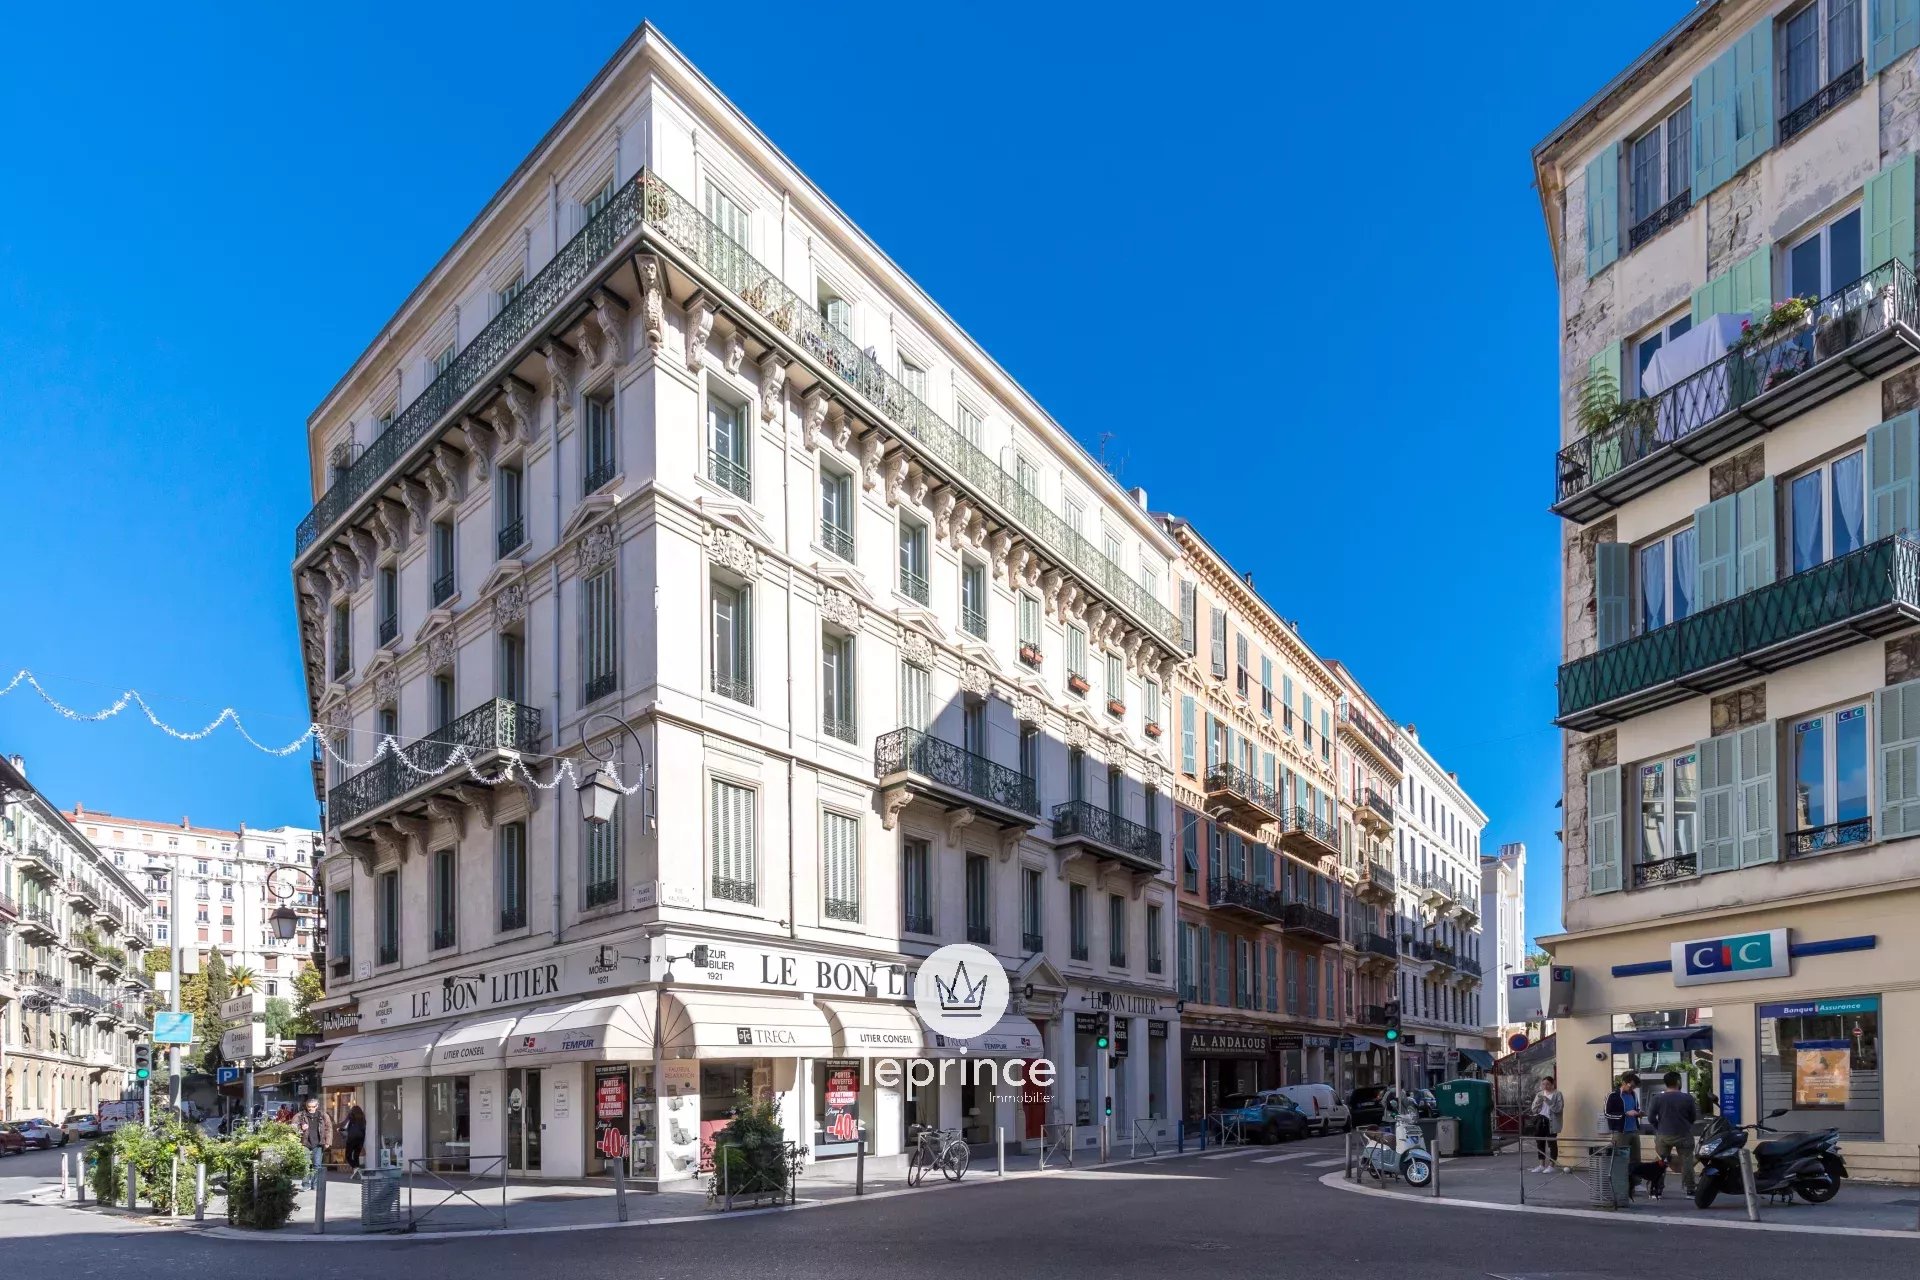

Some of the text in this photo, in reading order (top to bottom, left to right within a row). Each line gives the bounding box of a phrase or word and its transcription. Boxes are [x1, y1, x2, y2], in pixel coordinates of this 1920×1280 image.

[1692, 941, 1761, 969] CIC
[707, 971, 723, 981] 1921
[760, 954, 797, 986] LE
[816, 961, 869, 992] BON
[597, 975, 609, 985] 1921
[411, 964, 559, 1019] LE BON LITIER
[1128, 995, 1156, 1015] LITIER
[1783, 1002, 1861, 1015] Banque Assurance
[754, 1029, 796, 1044] TRECA
[860, 1033, 913, 1044] LITIER CONSEIL
[1191, 1034, 1206, 1047] AL
[1211, 1036, 1266, 1049] ANDALOUS
[561, 1039, 595, 1050] TEMPUR
[443, 1046, 485, 1060] LITIER CONSEIL
[378, 1061, 399, 1071] TEMPUR
[223, 1070, 234, 1082] P
[834, 1071, 851, 1079] PORTES
[603, 1079, 619, 1087] PORTES
[600, 1086, 621, 1095] OUVERTES
[826, 1113, 859, 1141] -40%
[596, 1127, 630, 1158] -40%
